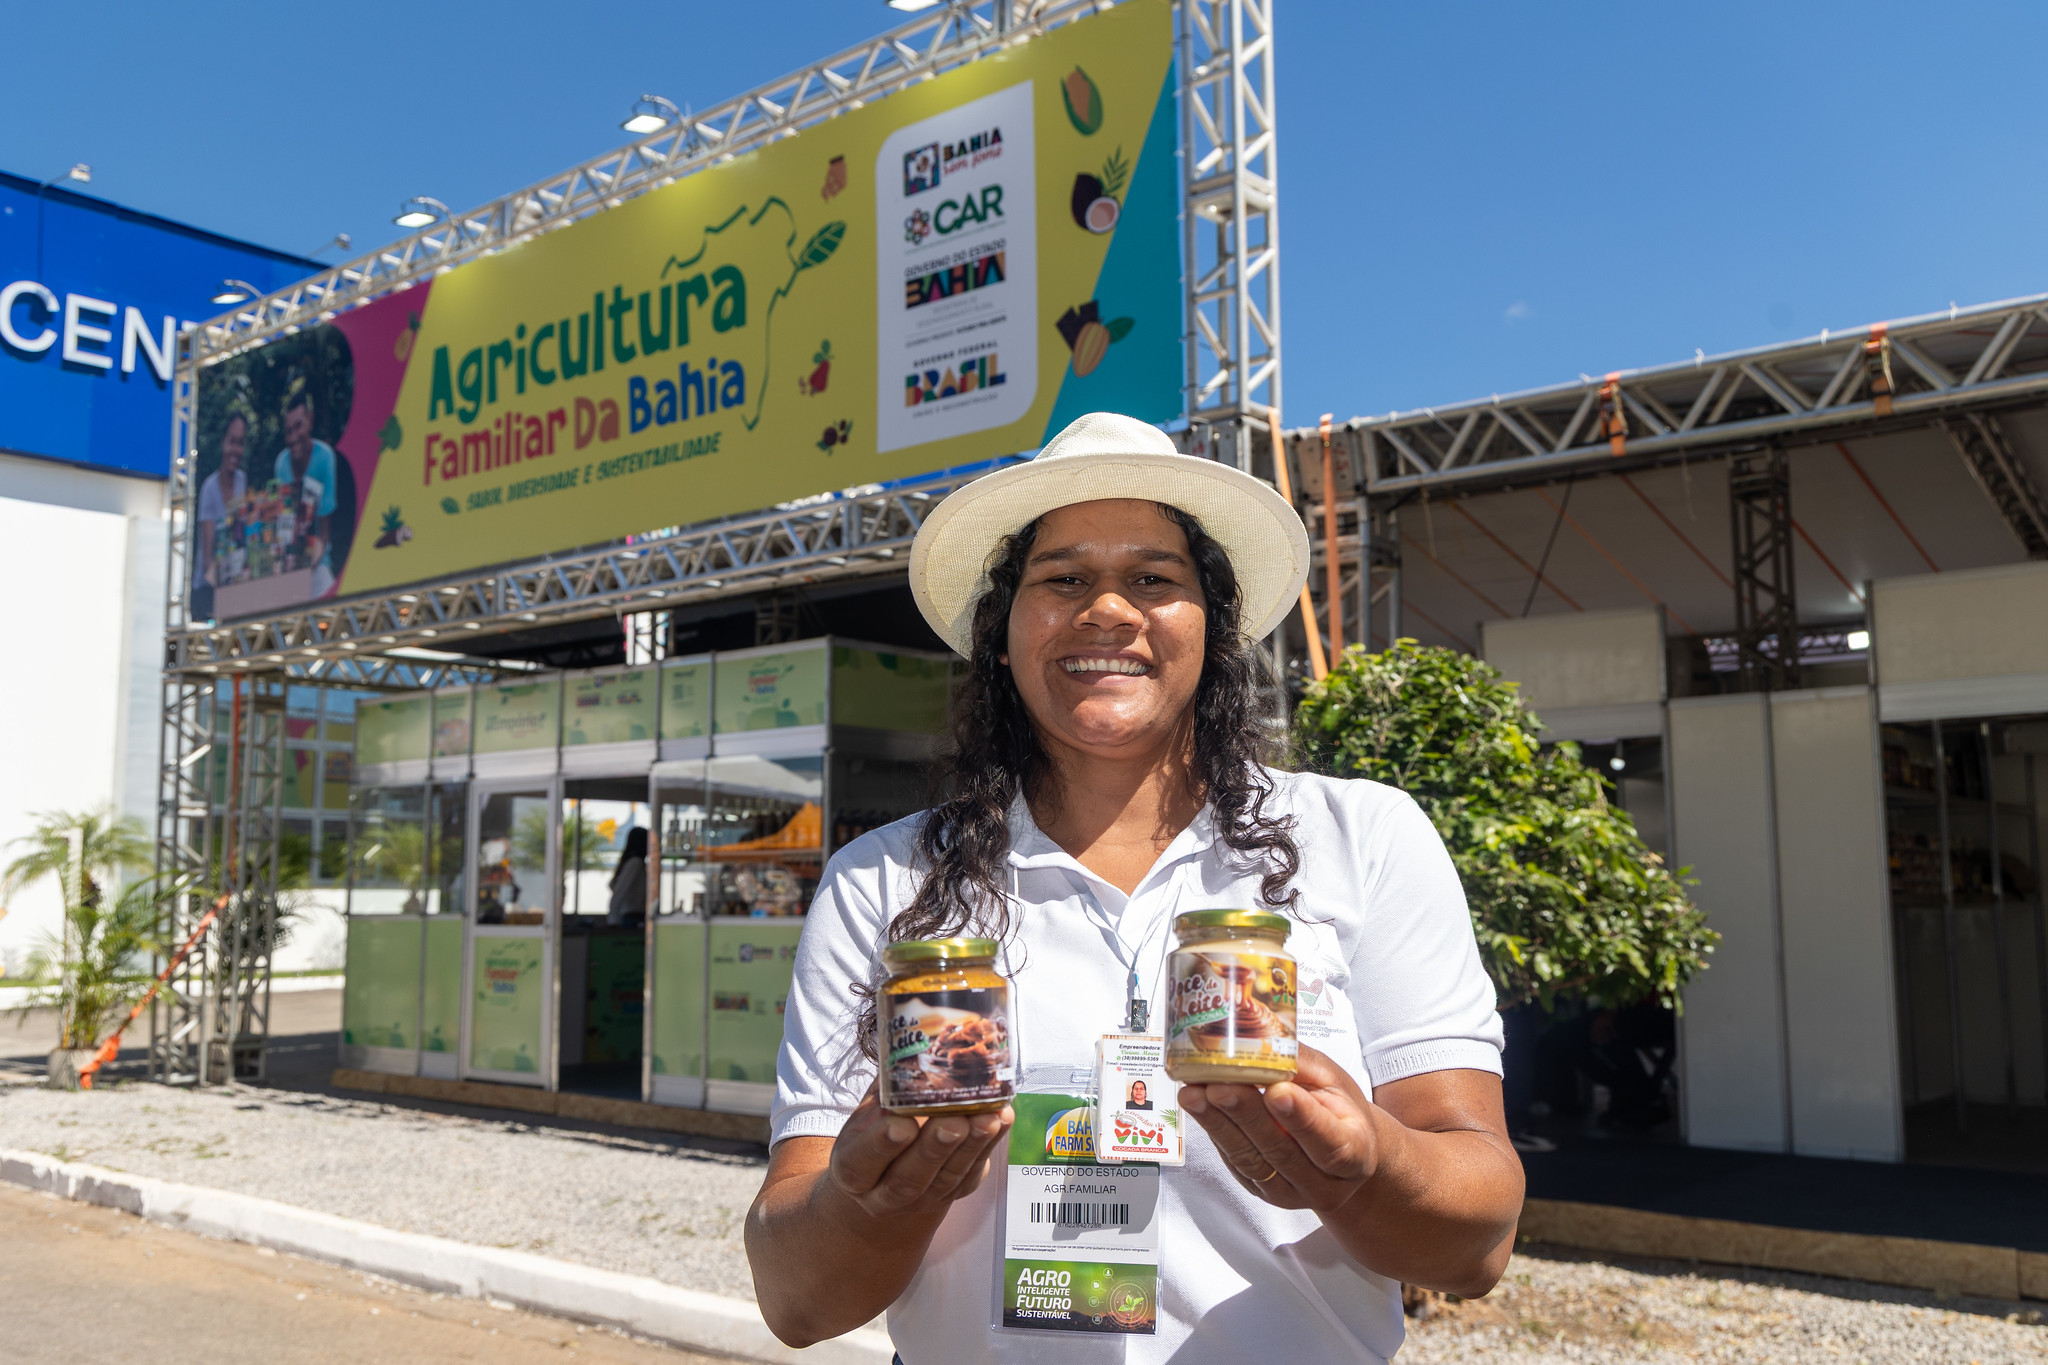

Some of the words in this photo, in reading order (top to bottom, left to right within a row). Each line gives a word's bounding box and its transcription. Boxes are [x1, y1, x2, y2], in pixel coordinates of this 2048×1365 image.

[942, 126, 1003, 162] BAHIA
[933, 184, 1004, 235] CAR
[905, 251, 1006, 310] BAHIA
[0, 281, 200, 381] CEN
[428, 264, 747, 424] Agricultura
[904, 352, 1007, 408] BRASIL
[424, 406, 567, 486] Familiar
[574, 396, 620, 450] Da
[628, 357, 746, 434] Bahia
[583, 464, 593, 484] E
[596, 432, 722, 481] SUSTENTABILIDADE
[1067, 1120, 1093, 1135] BAH
[1055, 1136, 1084, 1152] FARM
[1021, 1167, 1075, 1177] GOVERNO
[1077, 1167, 1093, 1177] DO
[1096, 1168, 1139, 1177] ESTADO
[1044, 1184, 1117, 1194] AGR.FAMILIAR
[1017, 1267, 1071, 1287] AGRO
[1017, 1286, 1070, 1296] INTELIGENTE
[1016, 1295, 1071, 1310] FUTURO
[1016, 1308, 1071, 1320] SUSTENTÁVEL
